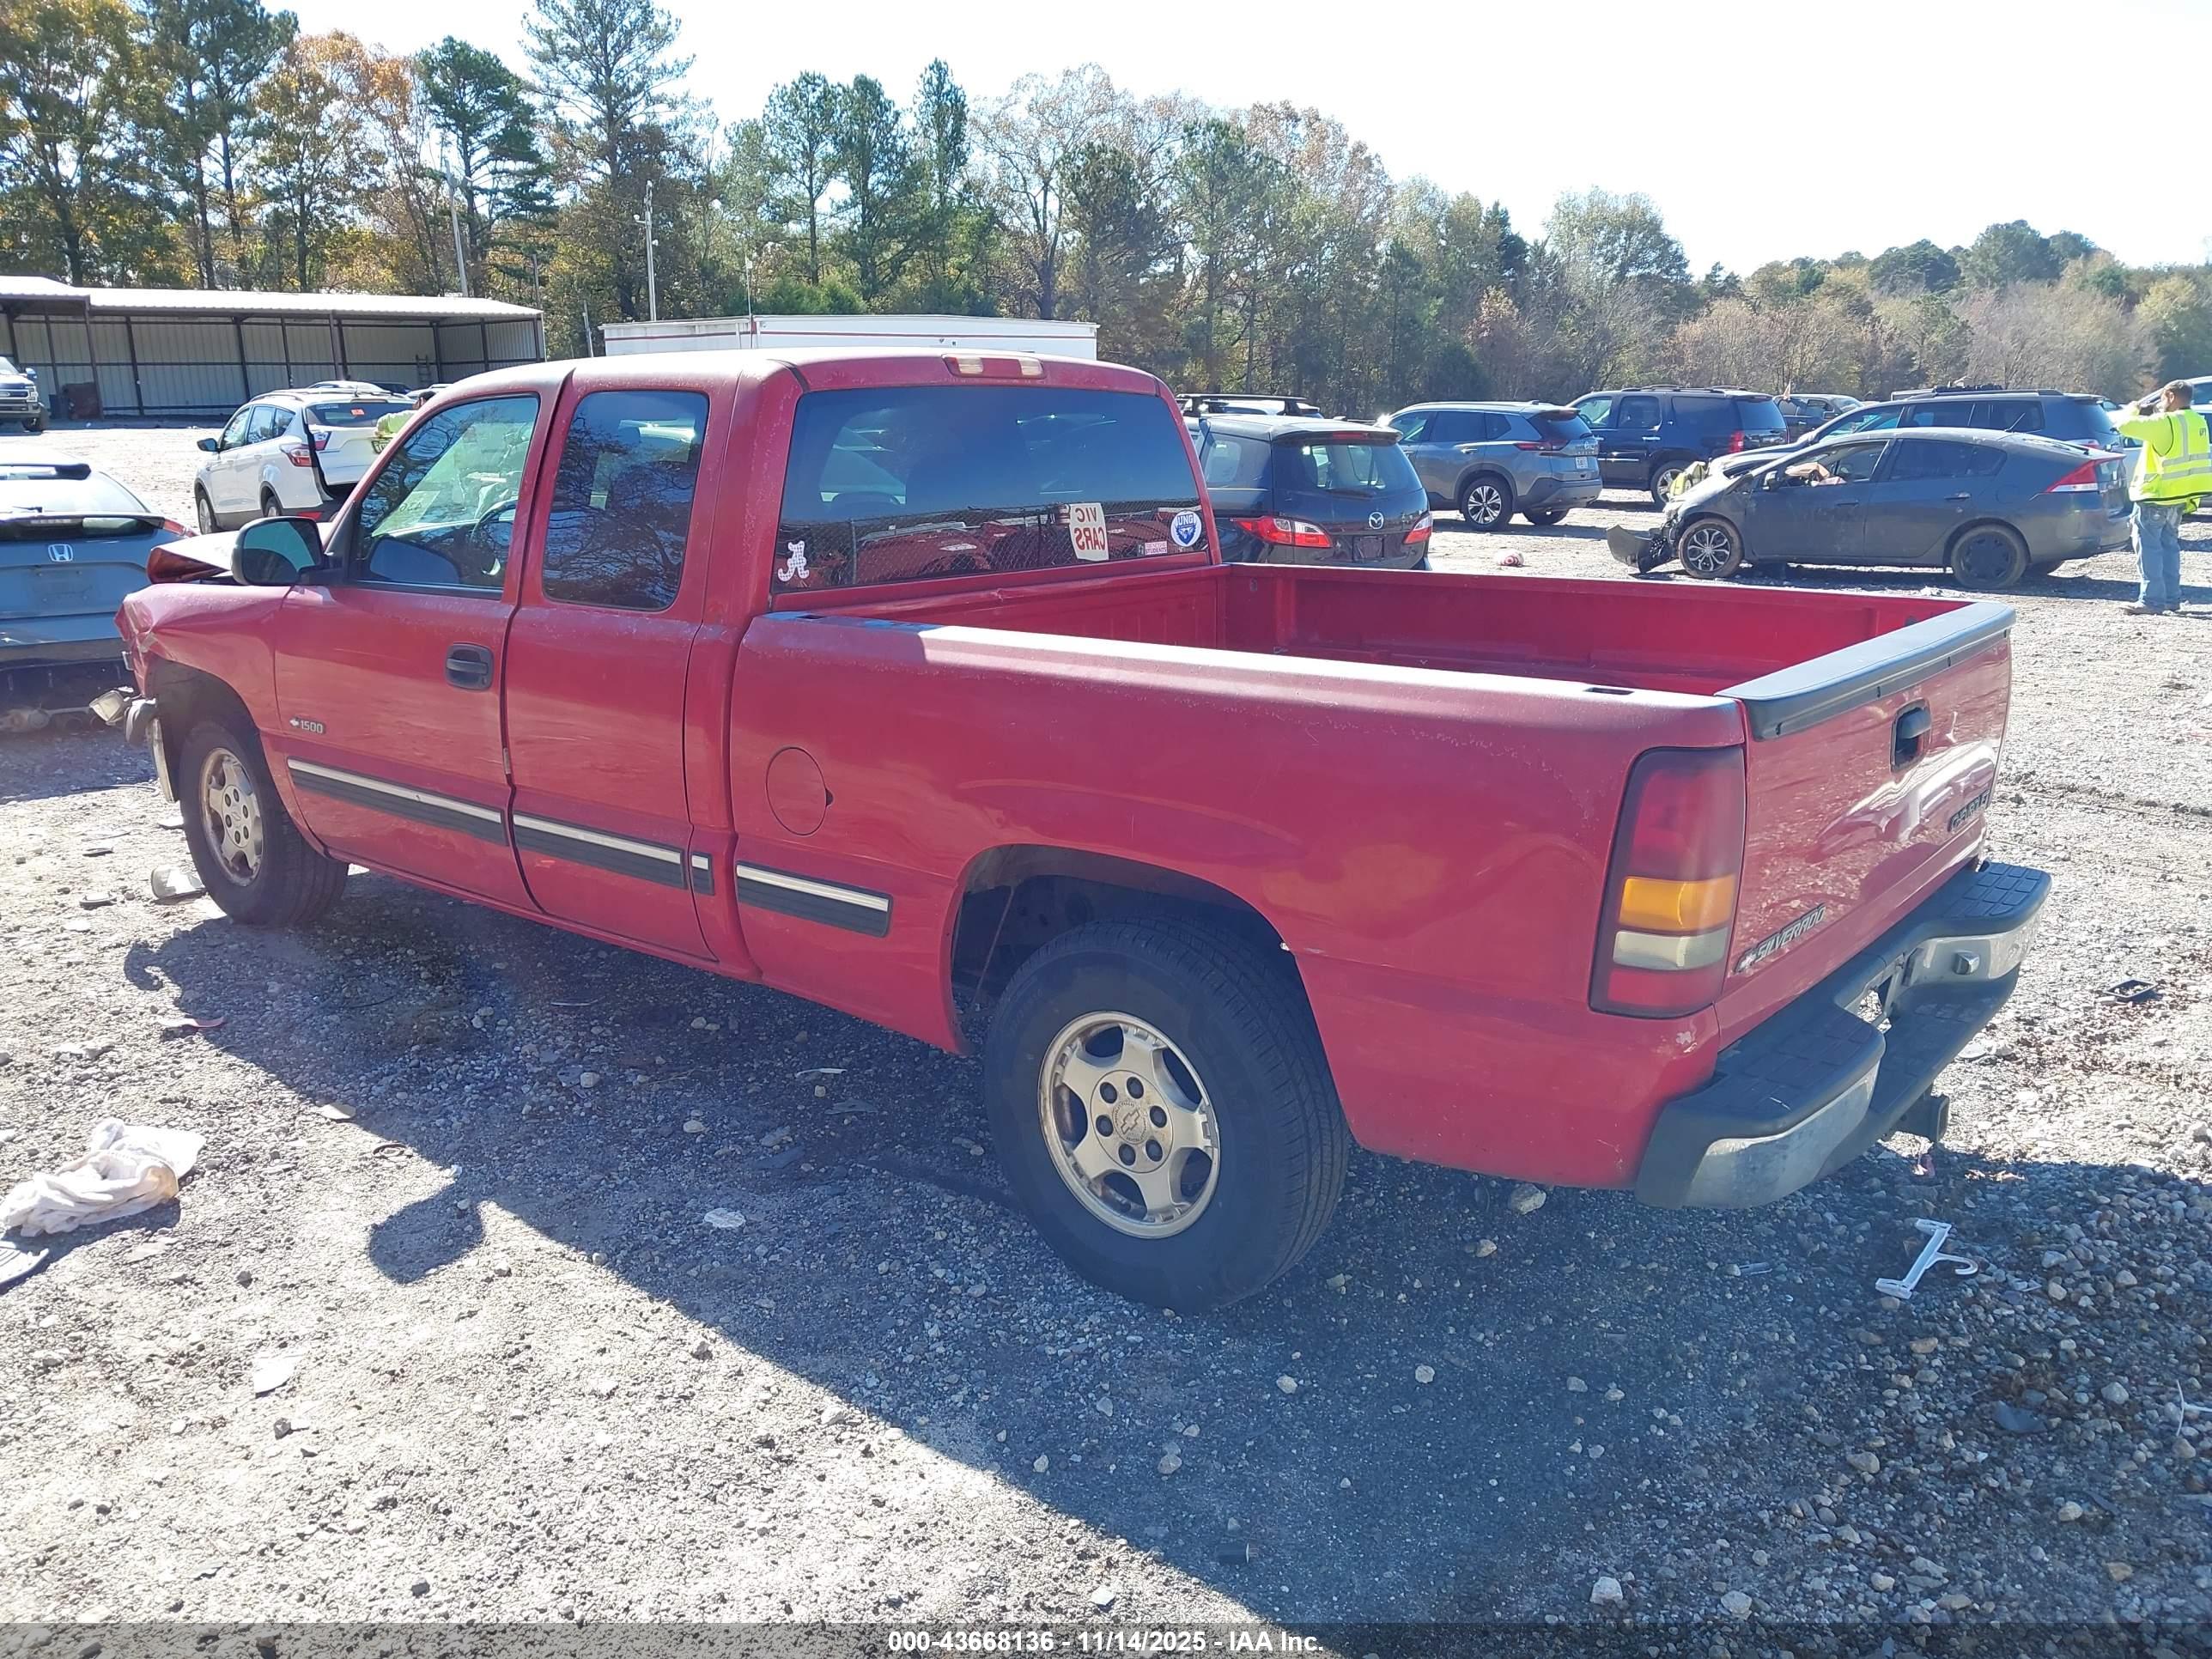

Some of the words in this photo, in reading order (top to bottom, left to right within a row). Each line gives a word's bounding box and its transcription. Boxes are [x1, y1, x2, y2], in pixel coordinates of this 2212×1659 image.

[1177, 514, 1194, 526] UNG
[301, 720, 324, 734] 1500
[1754, 905, 1826, 963] SILVERADO
